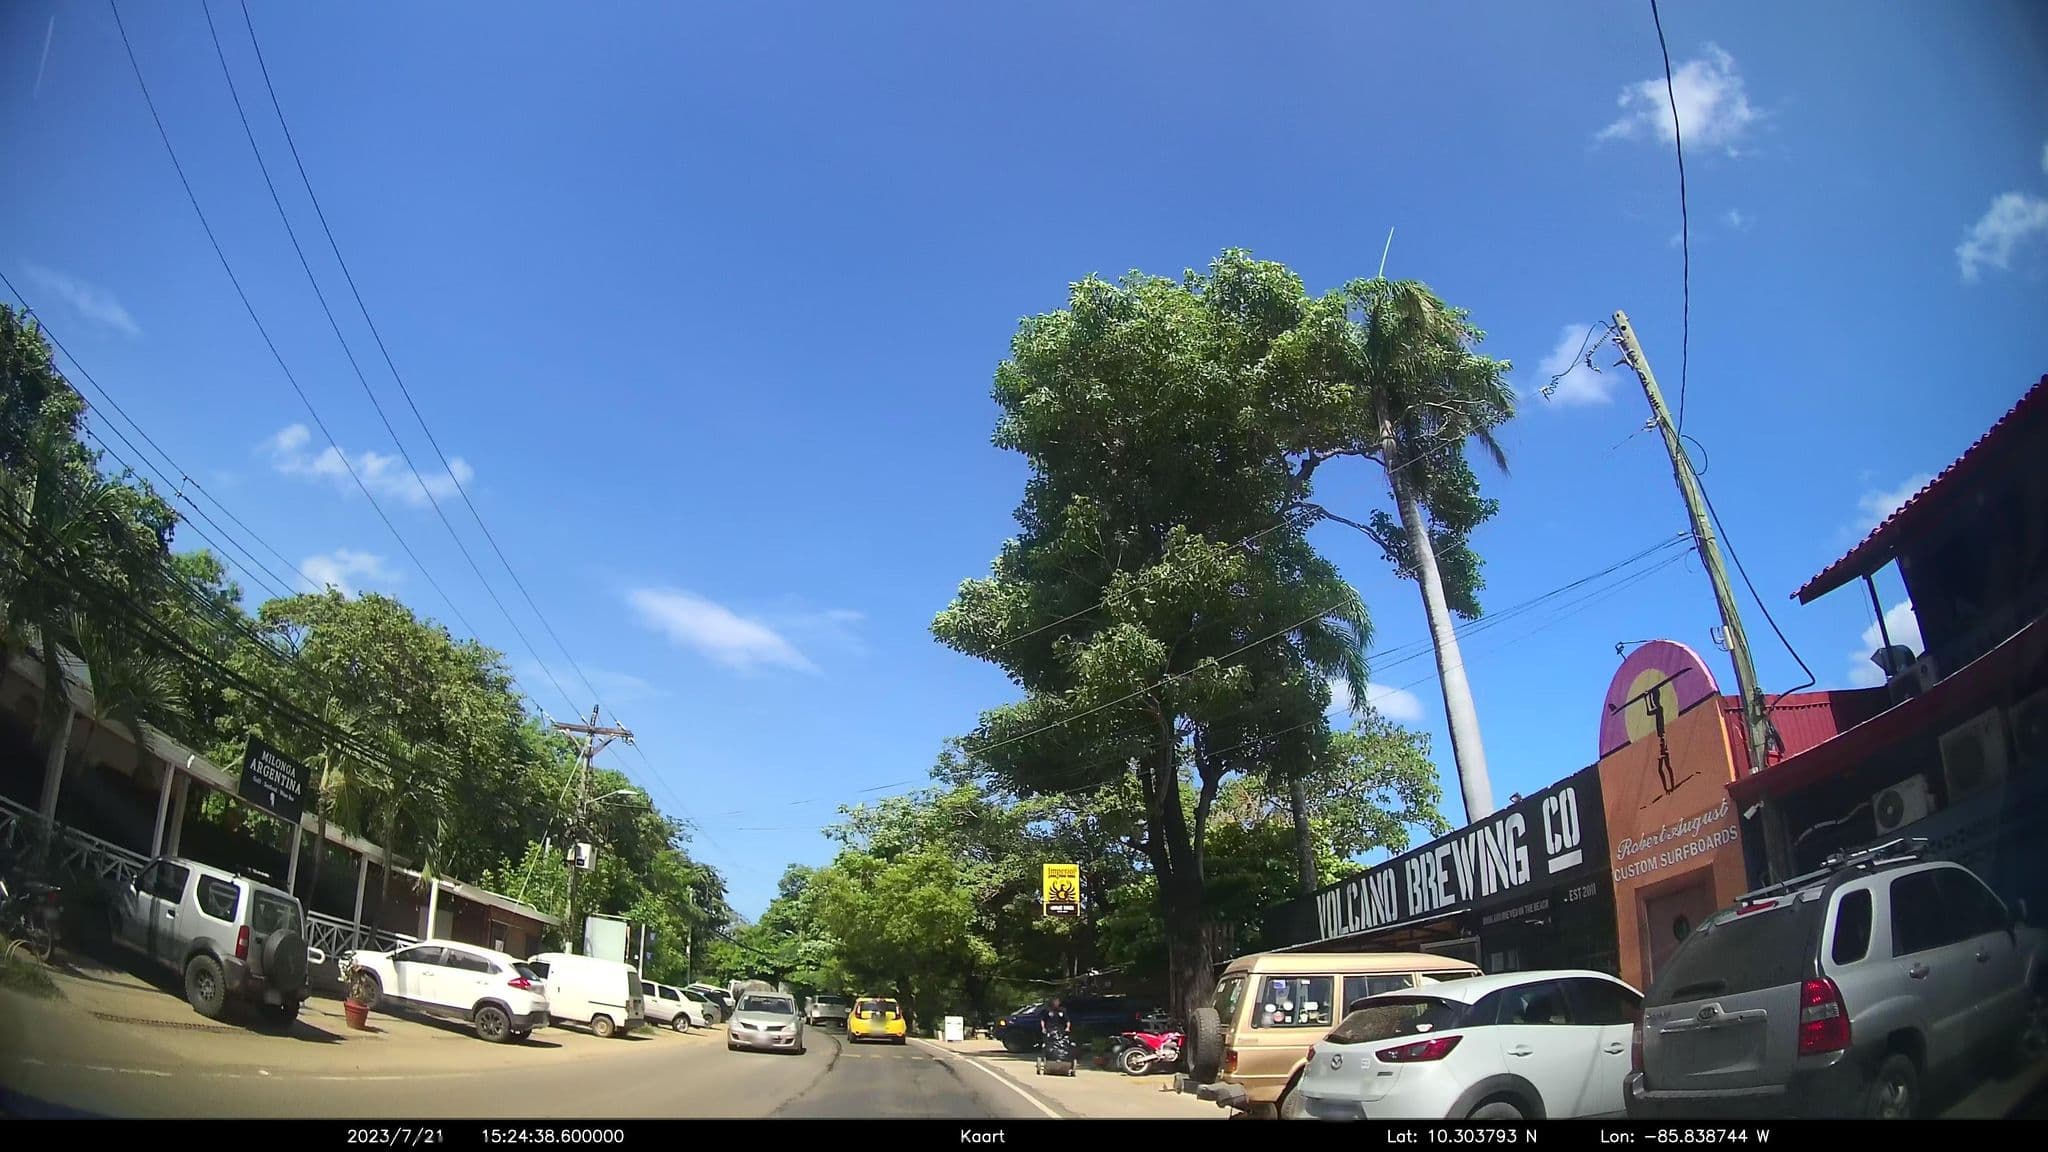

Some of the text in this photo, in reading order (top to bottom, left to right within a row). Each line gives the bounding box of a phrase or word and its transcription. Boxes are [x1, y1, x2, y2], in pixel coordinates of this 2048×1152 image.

[250, 758, 301, 796] ARGENTINA
[262, 750, 296, 779] MILONGA
[1614, 825, 1738, 882] CUSTOM SURFBOARDS
[1616, 797, 1729, 861] Robert August
[1316, 787, 1582, 940] VOLCANO BREWING CO
